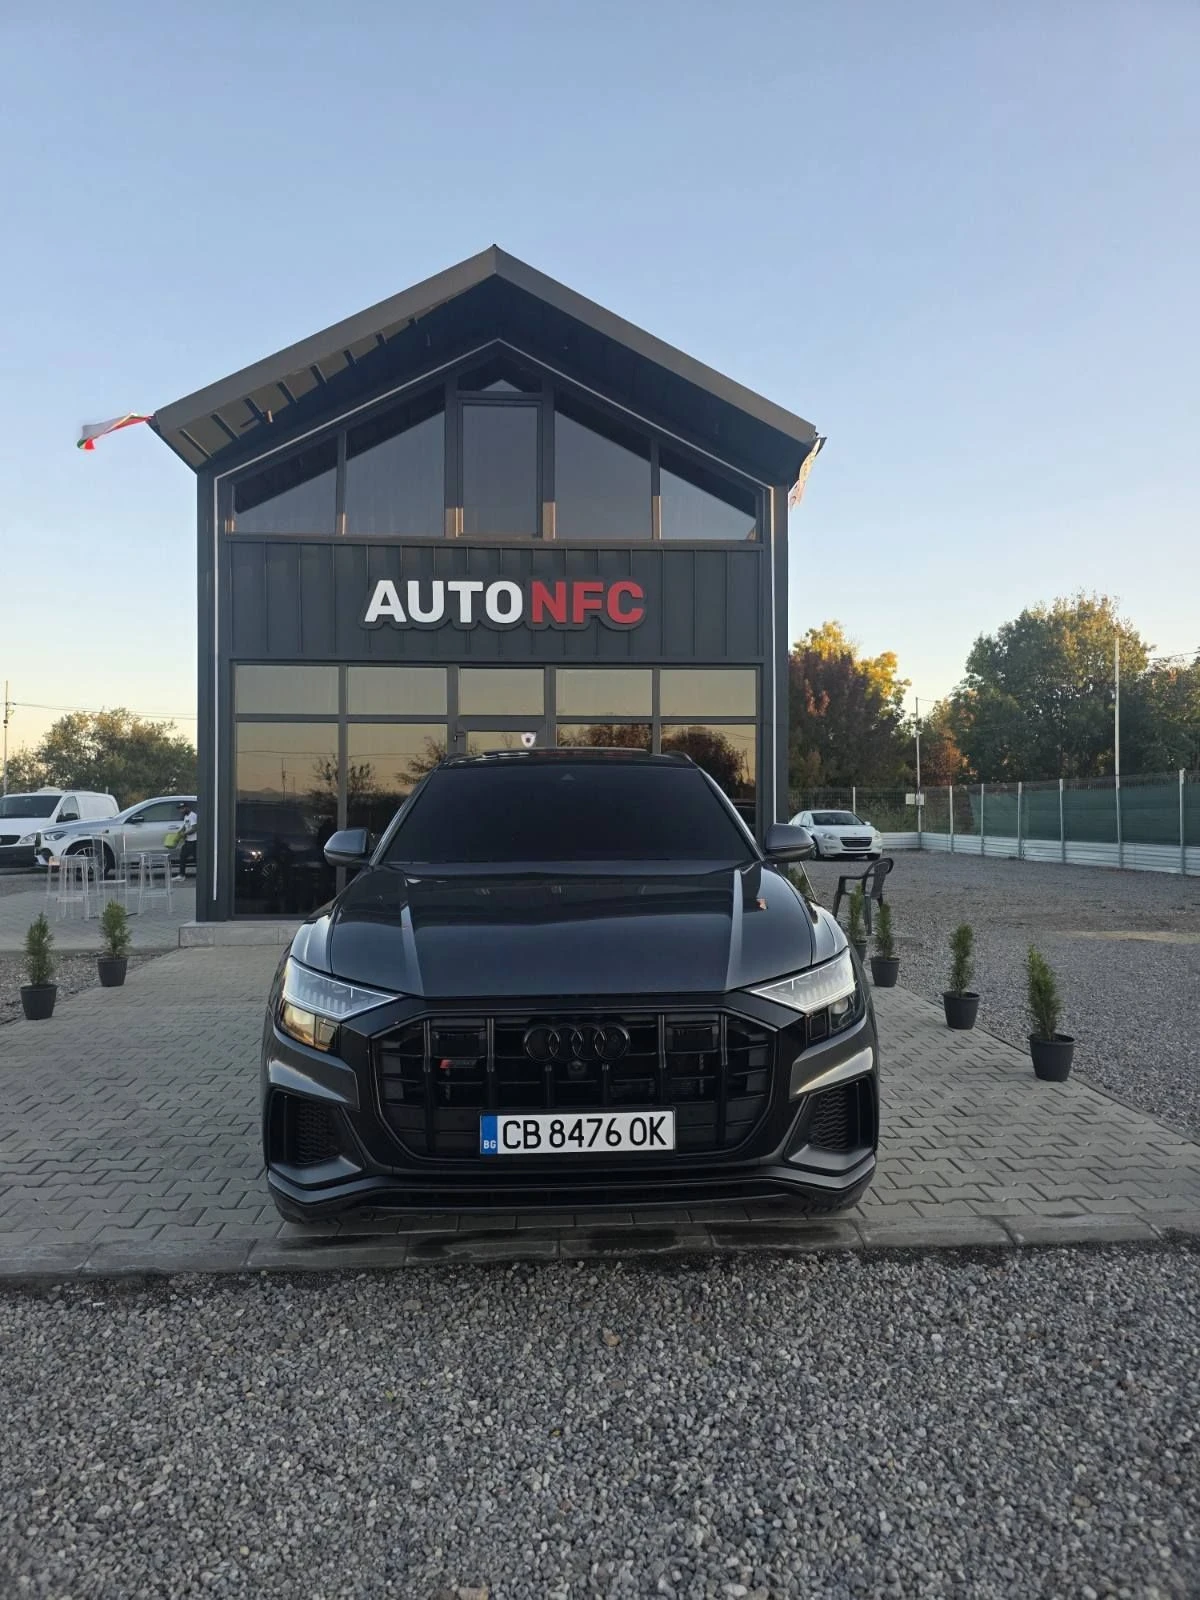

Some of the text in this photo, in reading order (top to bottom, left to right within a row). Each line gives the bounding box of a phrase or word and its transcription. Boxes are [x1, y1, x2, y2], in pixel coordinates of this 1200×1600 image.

[483, 1139, 497, 1149] BG
[502, 1116, 667, 1150] CB 8476 OK
